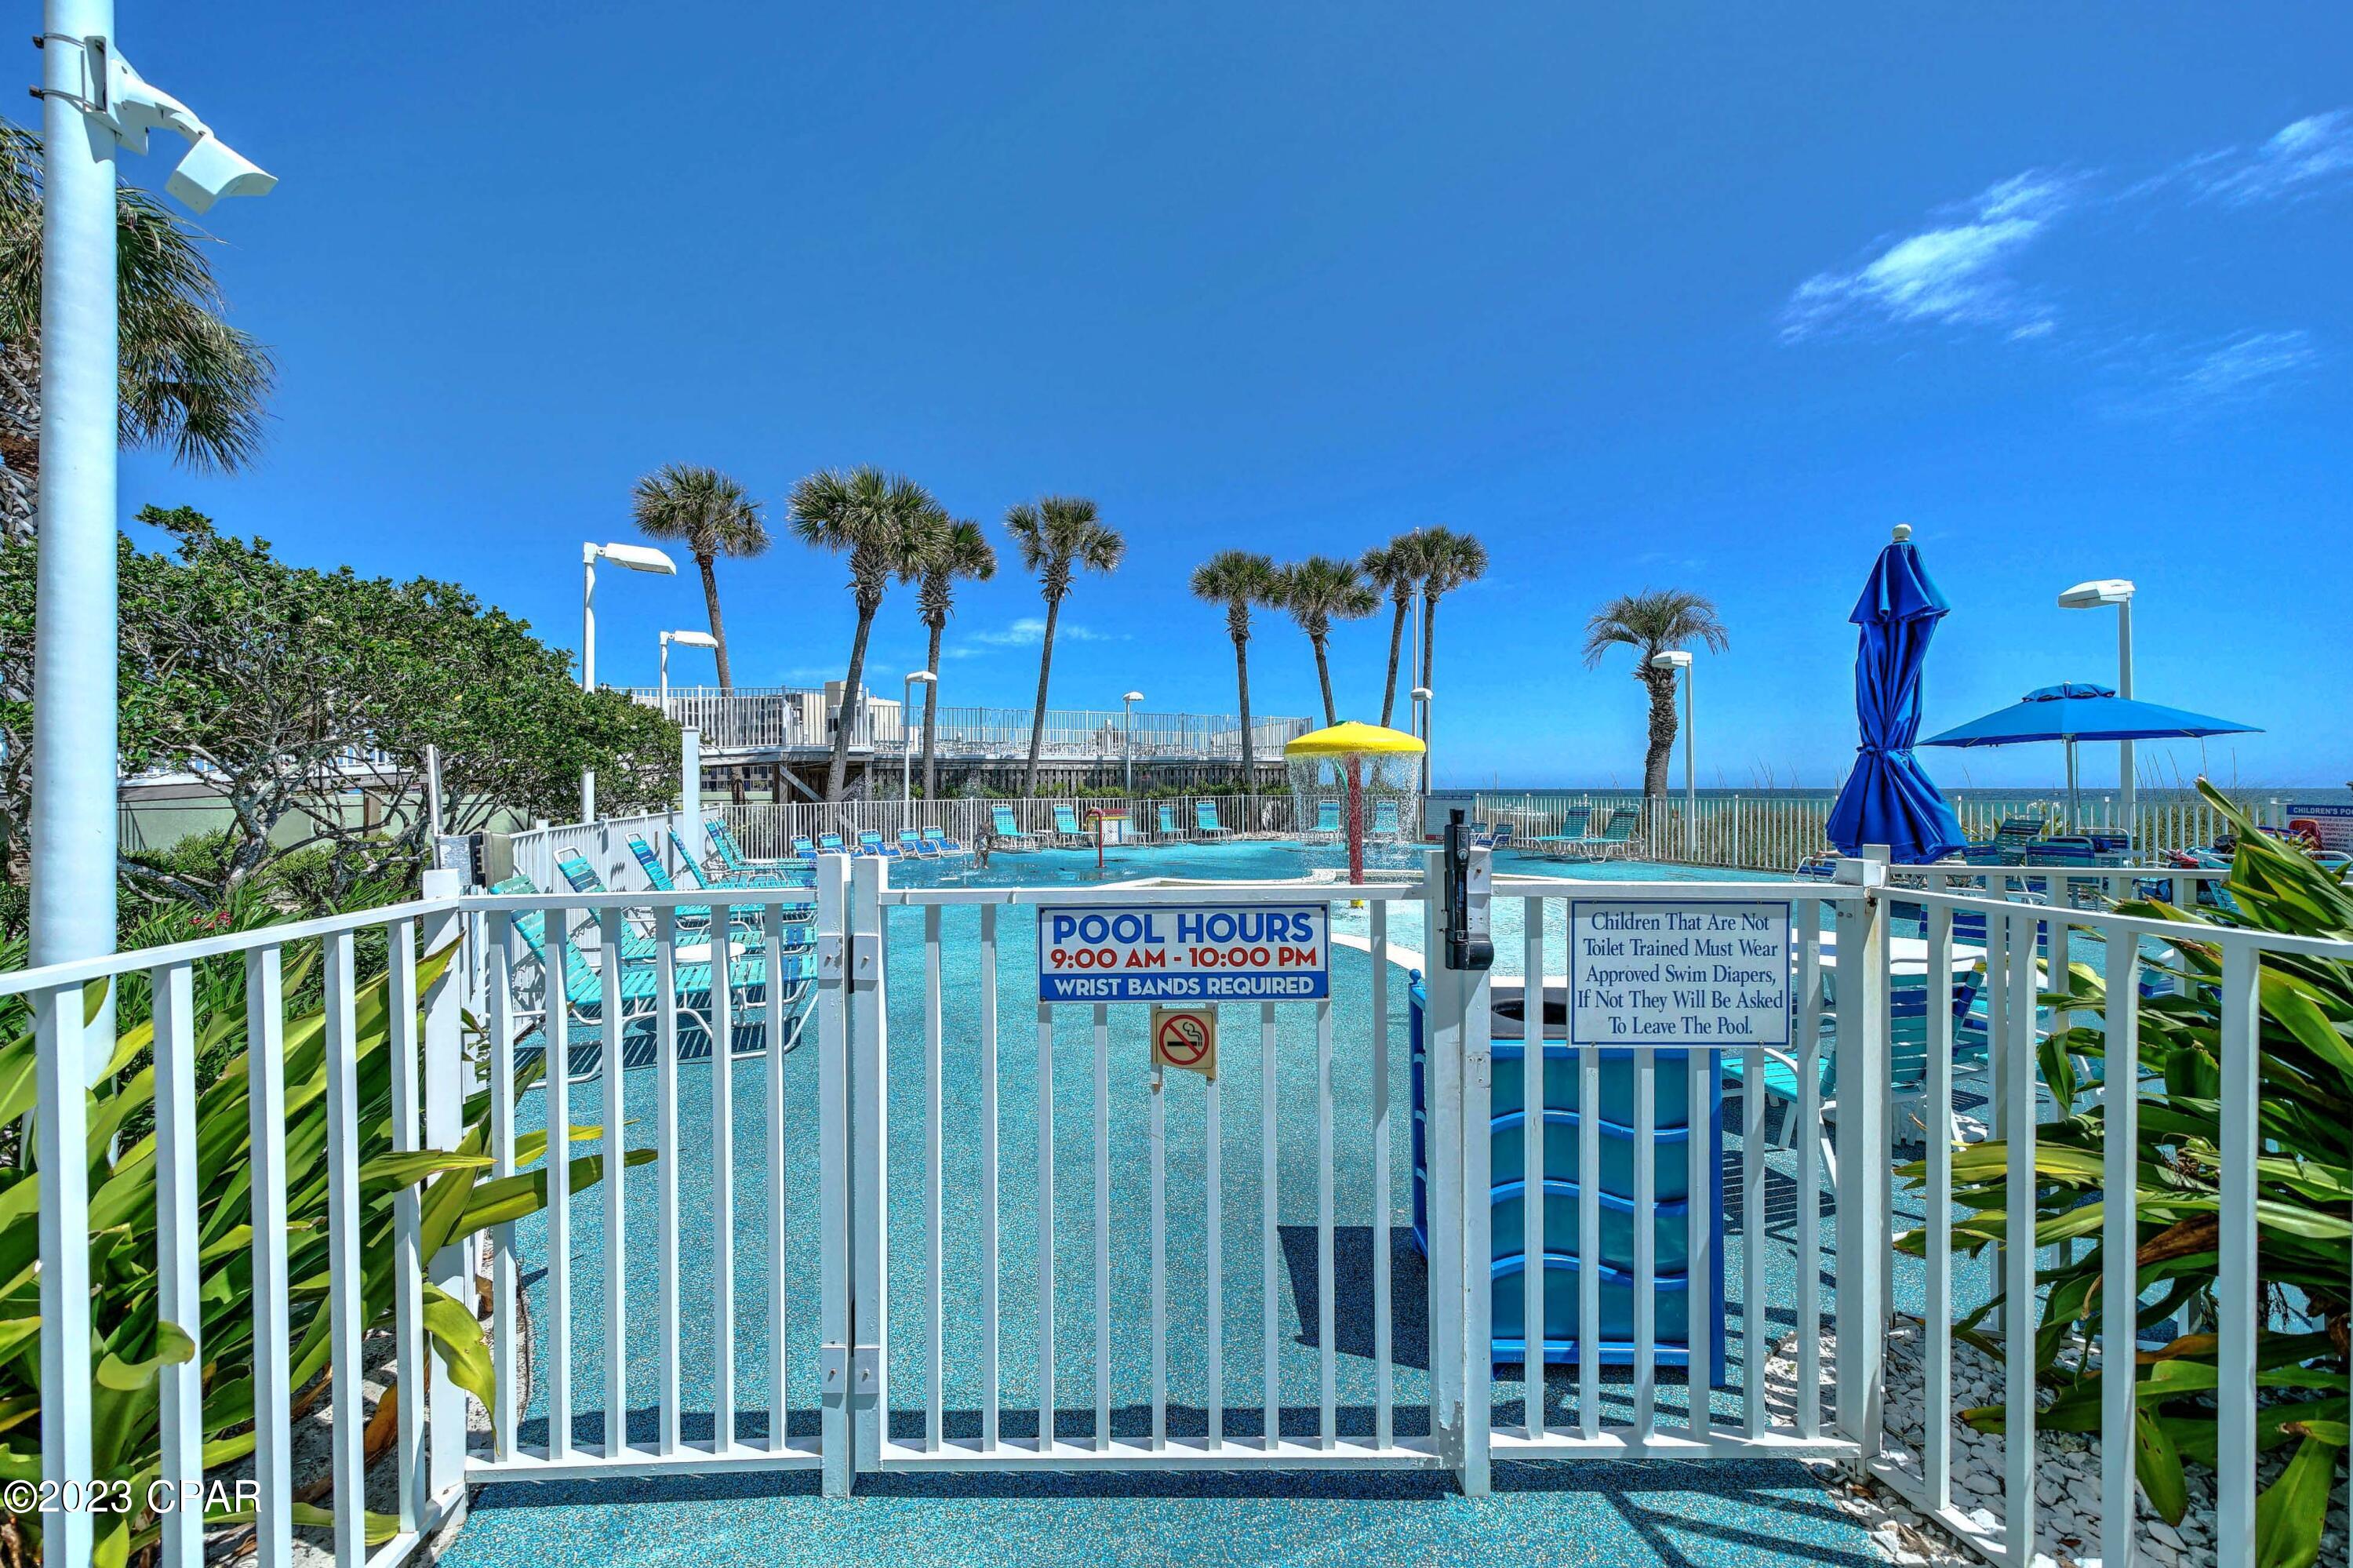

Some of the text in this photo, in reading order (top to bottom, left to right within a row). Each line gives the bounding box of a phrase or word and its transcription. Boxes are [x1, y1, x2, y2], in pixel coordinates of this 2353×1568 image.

[1053, 912, 1314, 944] POOL HOURS
[1591, 911, 1769, 931] Children That Are Not
[1050, 948, 1118, 969] 9:00
[1125, 948, 1166, 968] AM
[1189, 947, 1271, 967] 10:00
[1278, 946, 1317, 967] PM
[1584, 937, 1778, 957] Toilet Trained Must Wear
[1585, 963, 1777, 987] Approved Swim Diapers,
[1054, 977, 1315, 996] WRIST BANDS REQUIRED
[1577, 988, 1784, 1013] If Not They Will Be Asked
[1608, 1015, 1753, 1035] To Leave The Pool.
